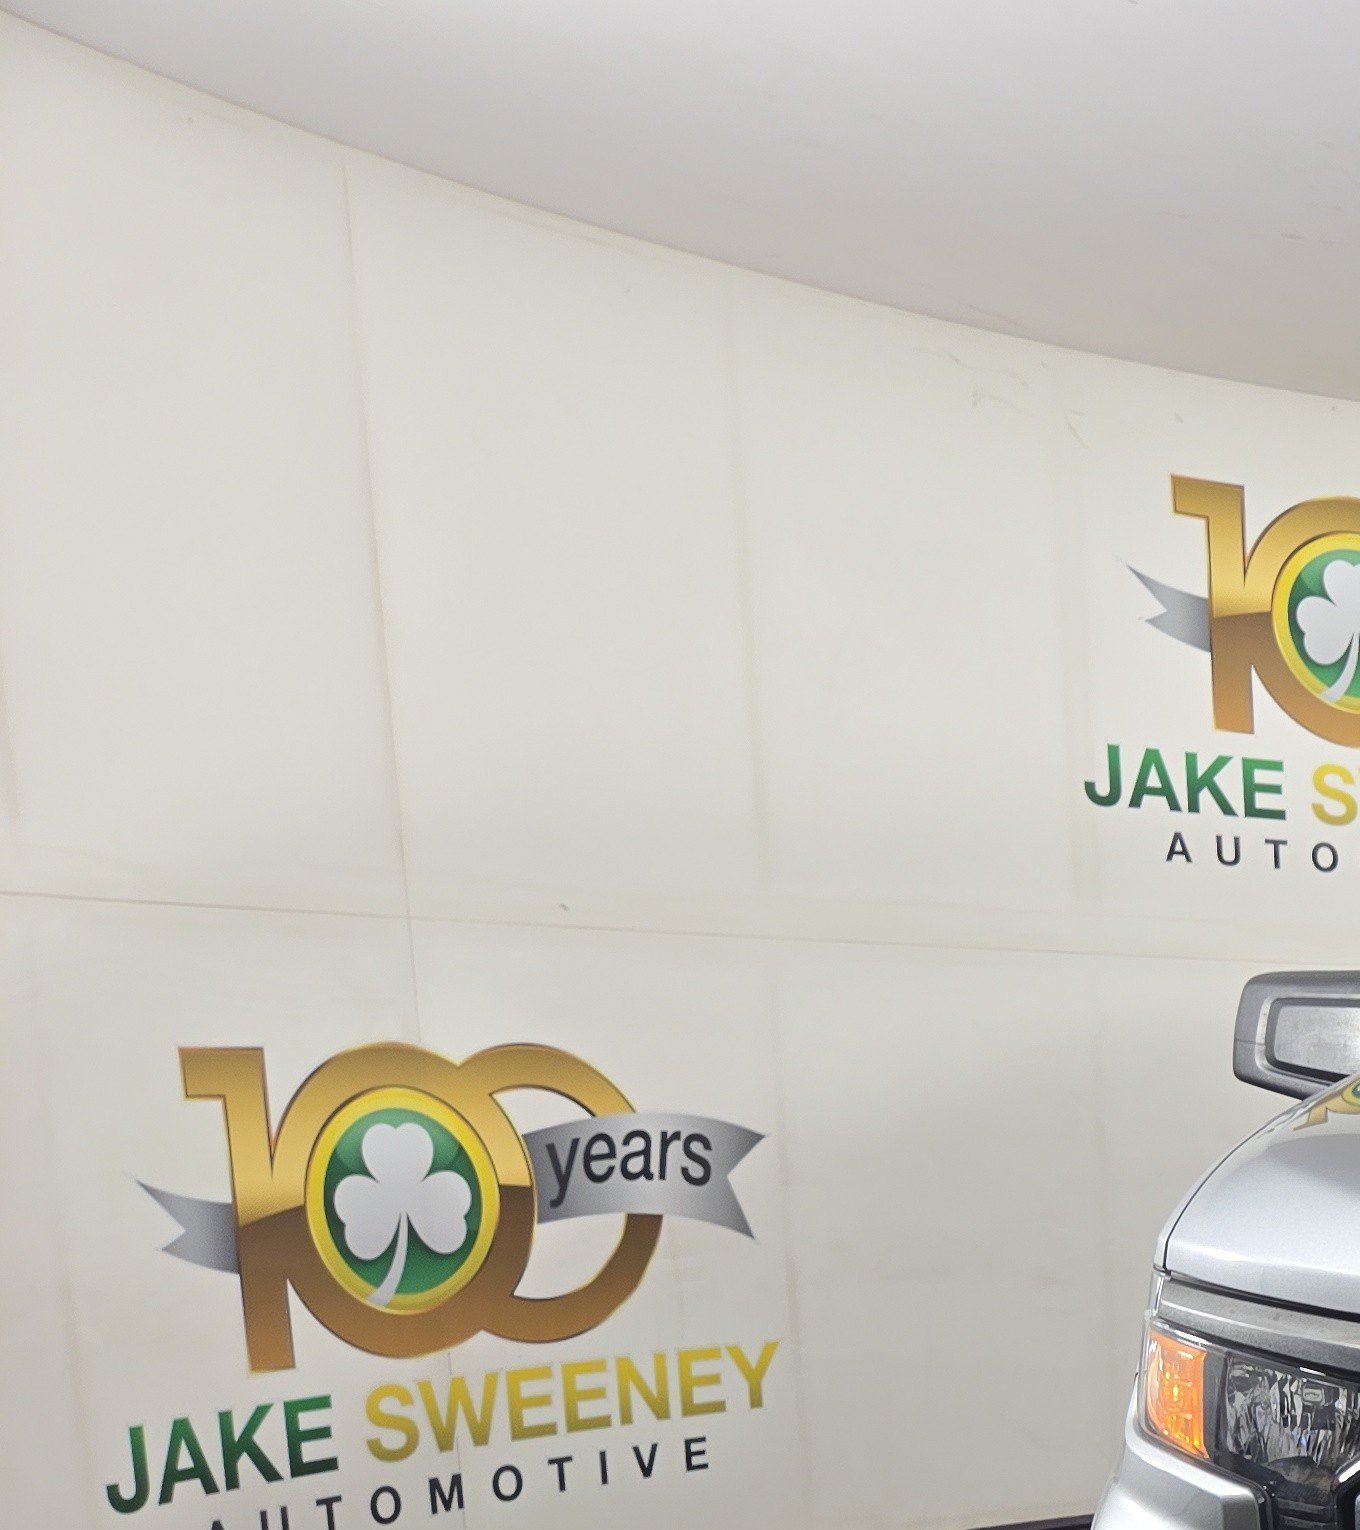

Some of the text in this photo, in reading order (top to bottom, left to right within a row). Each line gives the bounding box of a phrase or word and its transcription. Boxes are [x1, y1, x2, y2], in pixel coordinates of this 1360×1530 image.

[1084, 743, 1287, 821] JAKE
[178, 1041, 664, 1375] 100
[546, 1128, 712, 1209] years
[106, 1341, 780, 1515] JAKE SWEENEY
